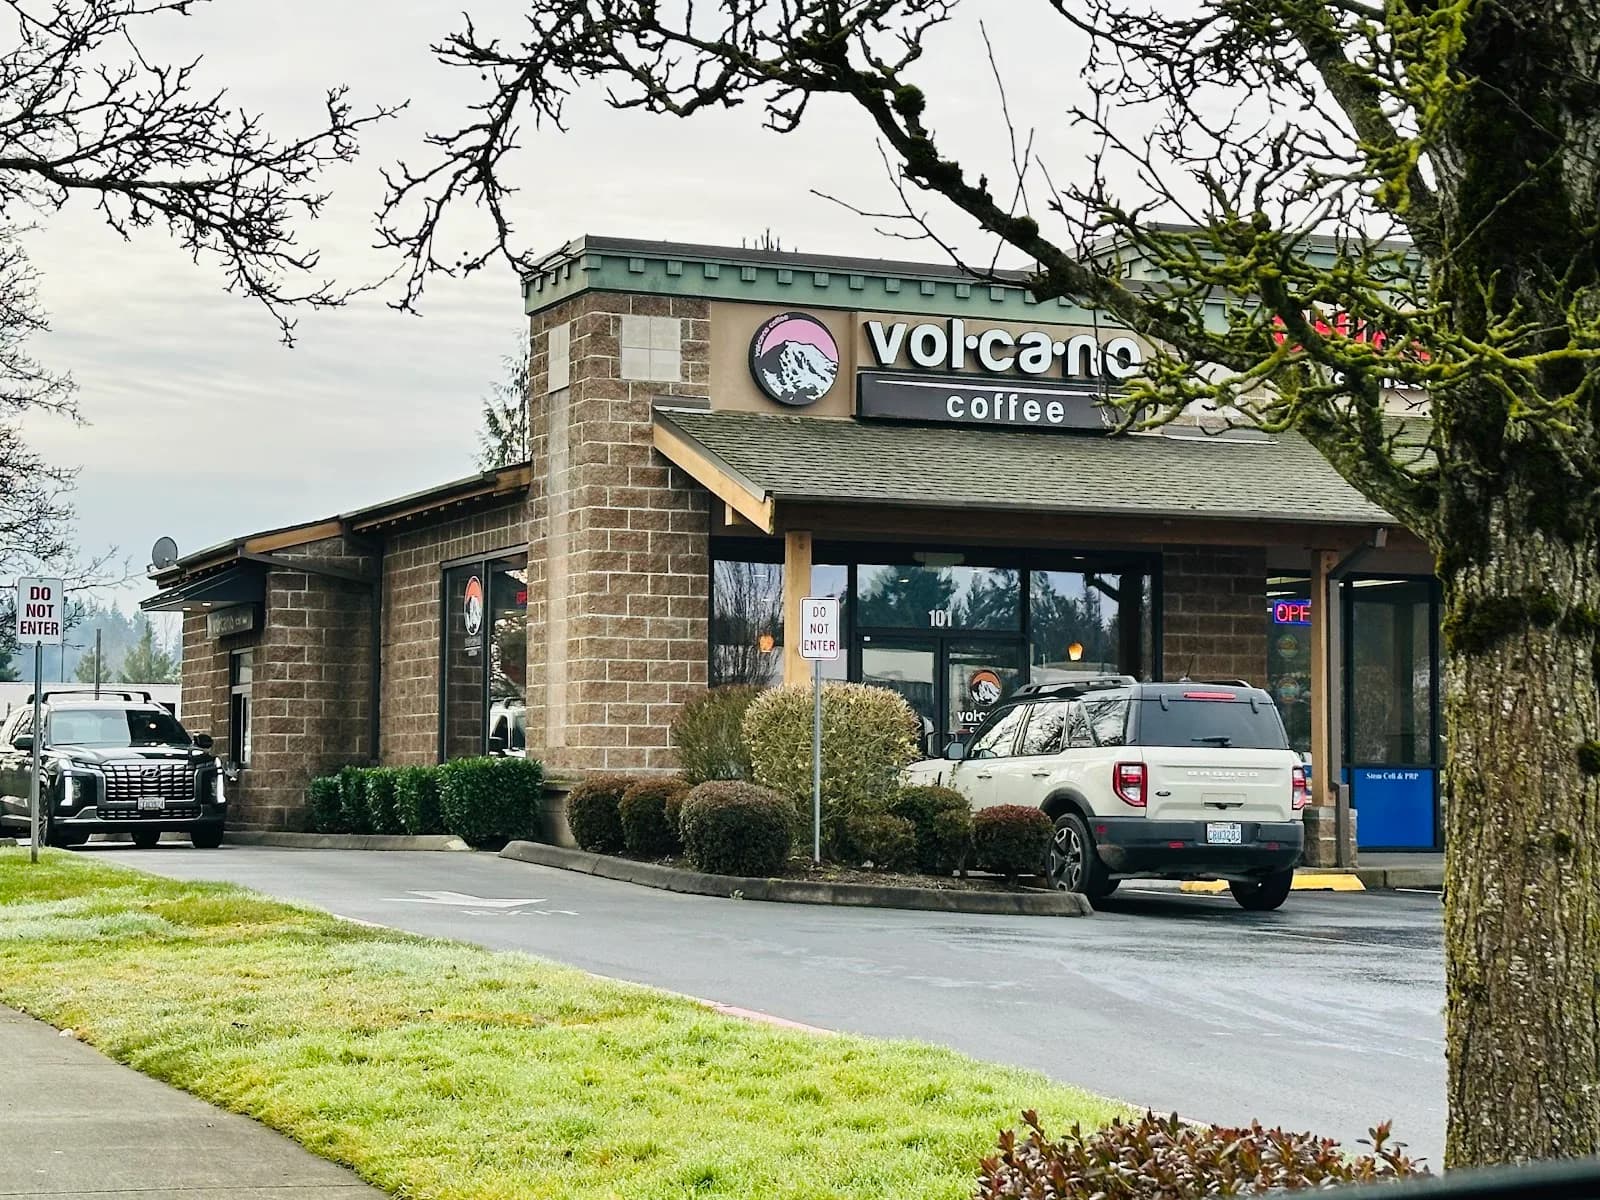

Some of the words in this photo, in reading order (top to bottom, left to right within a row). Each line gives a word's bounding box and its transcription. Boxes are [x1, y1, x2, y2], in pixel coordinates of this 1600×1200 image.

[946, 392, 1066, 424] coffee
[30, 586, 51, 601] DO
[26, 603, 55, 618] NOT
[812, 606, 826, 618] DO
[928, 609, 952, 627] 101
[1276, 603, 1311, 622] OPE
[20, 620, 59, 636] ENTER
[810, 623, 829, 634] NOT
[804, 639, 836, 651] ENTER
[1186, 770, 1259, 778] BRONCO
[1396, 772, 1404, 780] &
